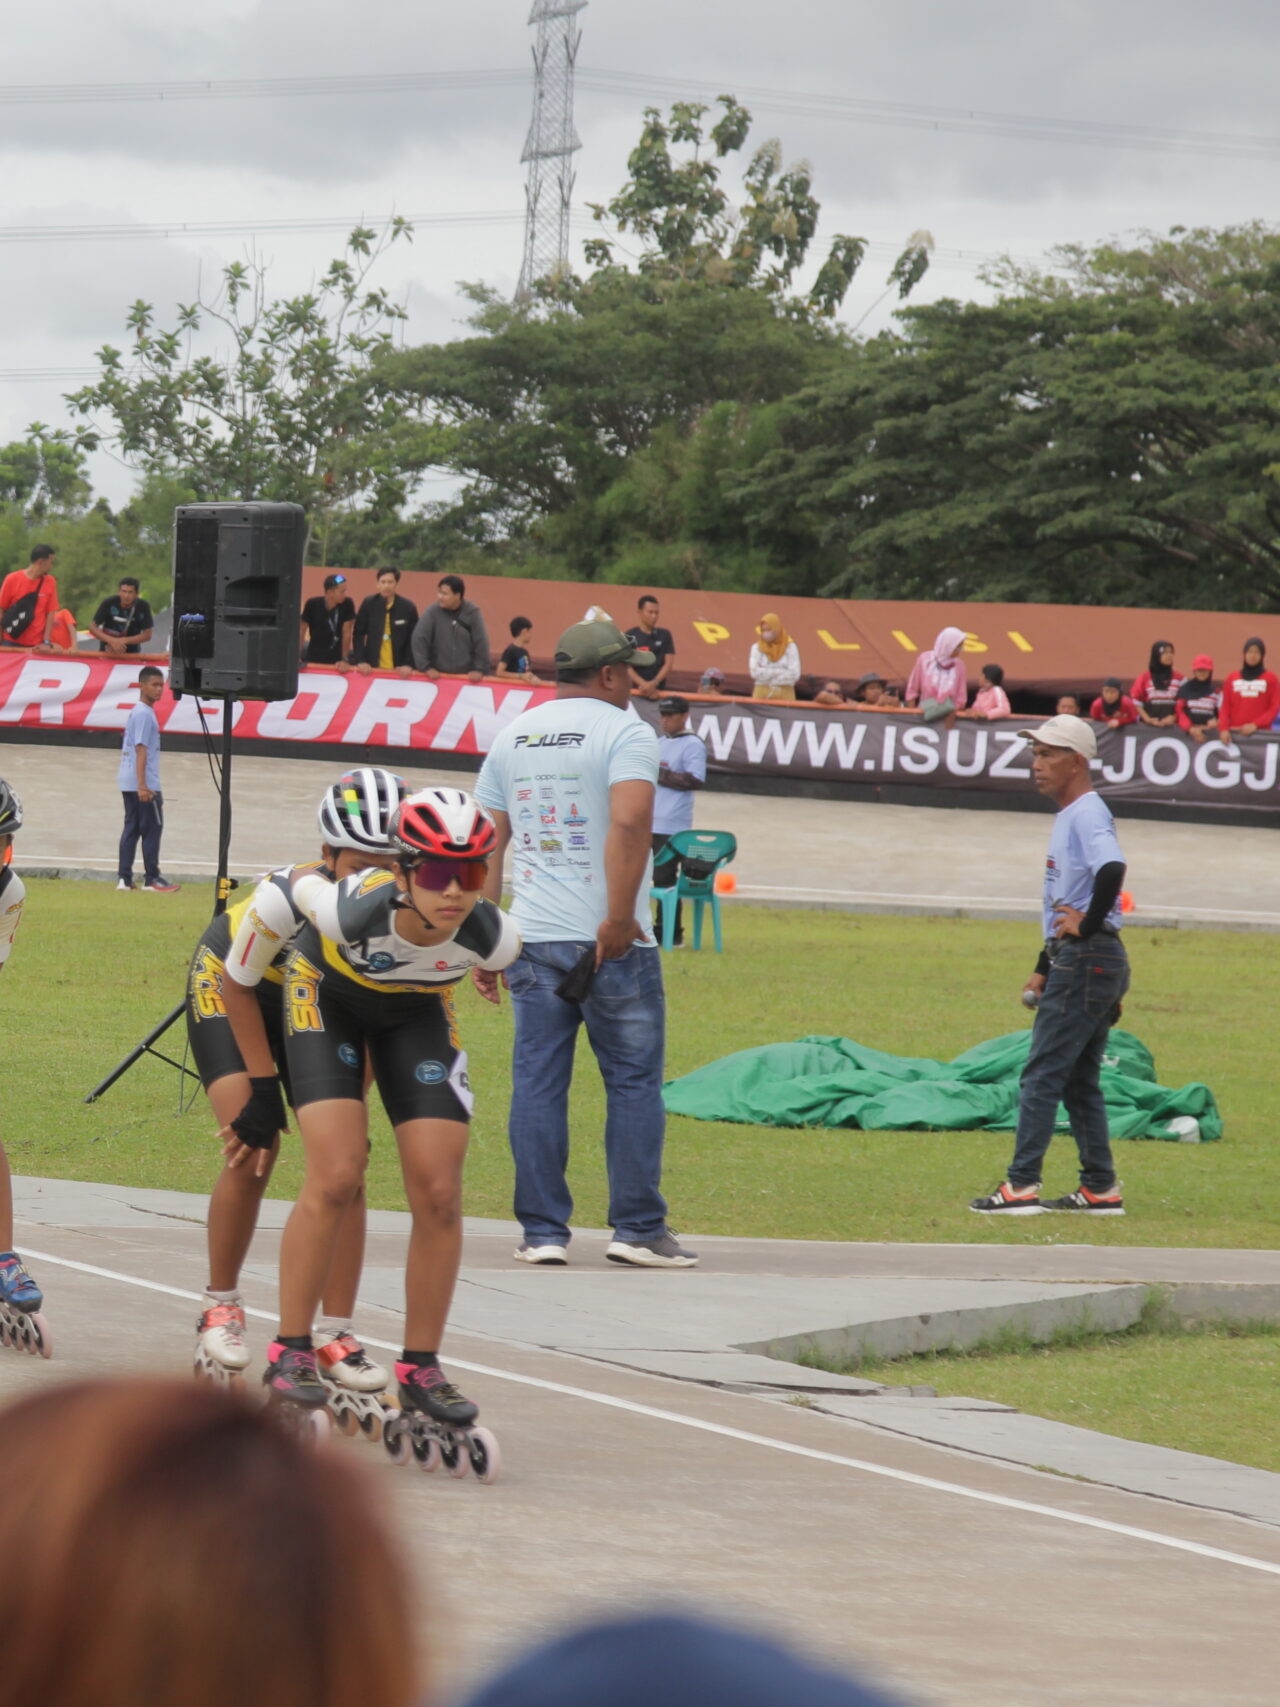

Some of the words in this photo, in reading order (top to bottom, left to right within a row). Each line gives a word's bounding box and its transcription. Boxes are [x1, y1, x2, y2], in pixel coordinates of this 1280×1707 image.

[692, 620, 1034, 652] PLISI
[514, 732, 587, 749] POWER
[685, 713, 1279, 791] WWW.ISUZ-JOGJ
